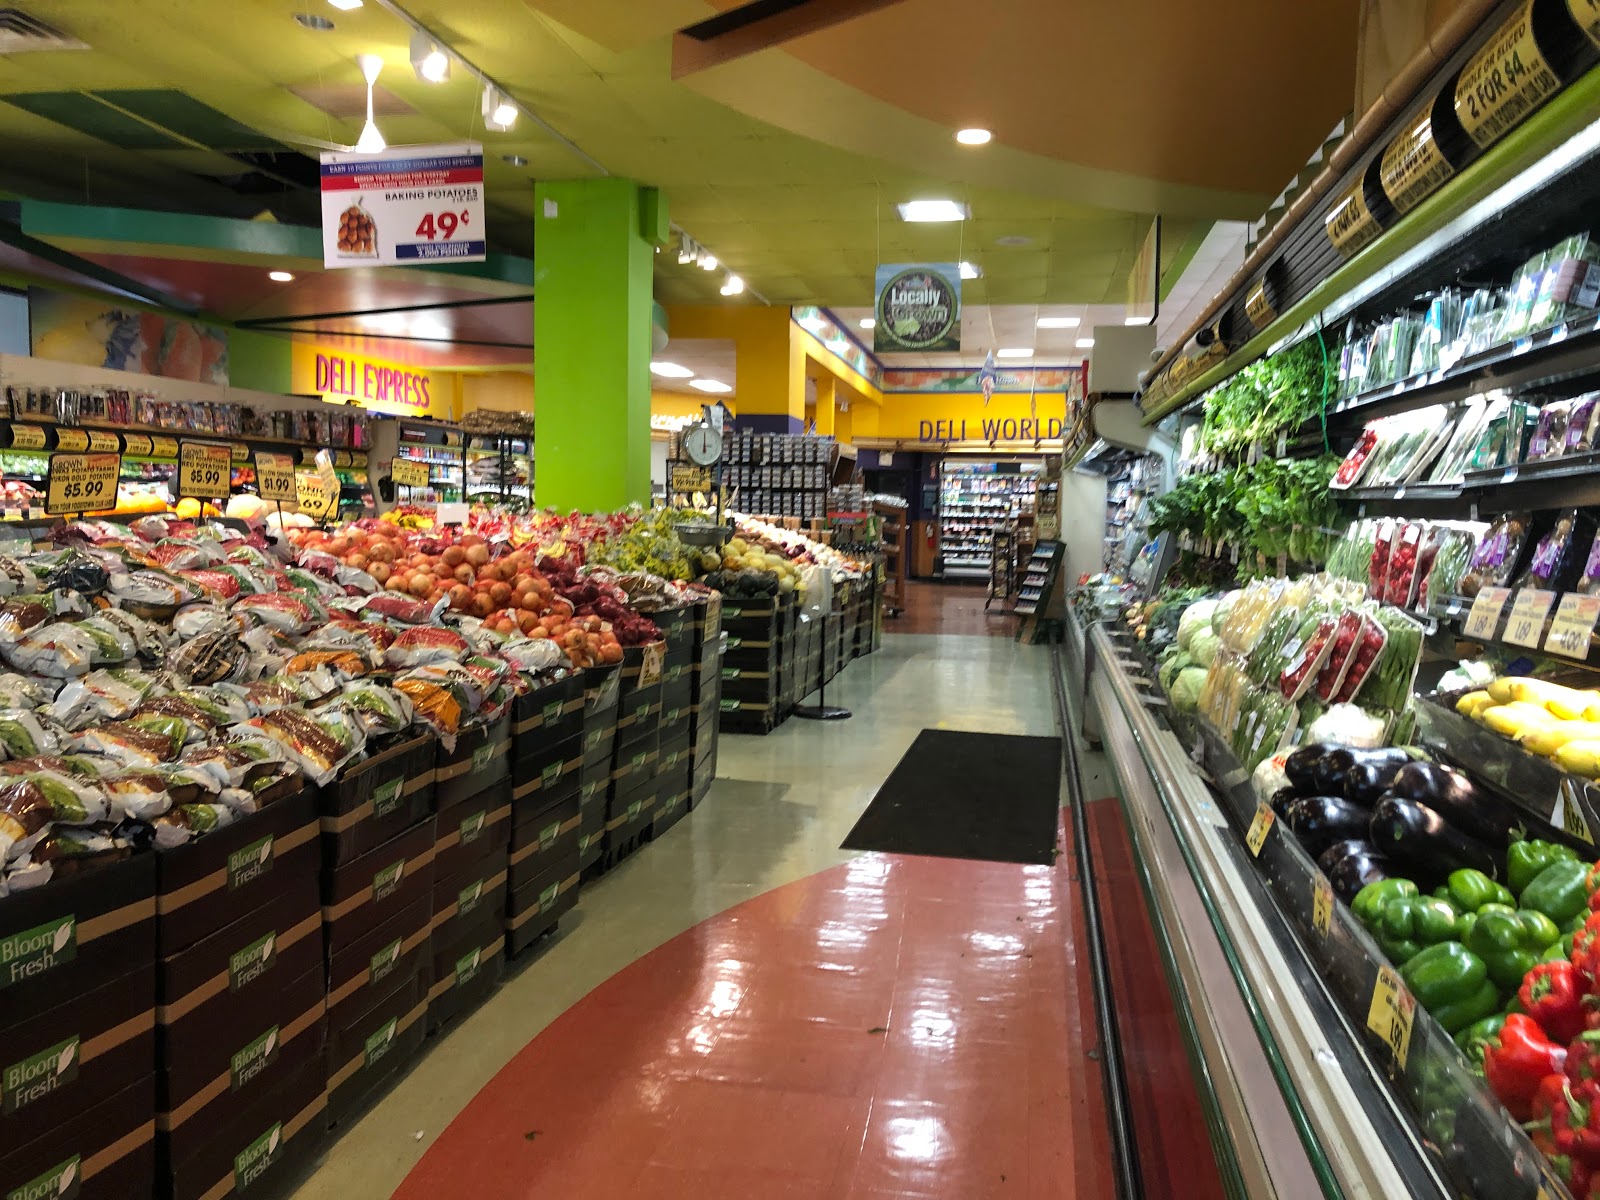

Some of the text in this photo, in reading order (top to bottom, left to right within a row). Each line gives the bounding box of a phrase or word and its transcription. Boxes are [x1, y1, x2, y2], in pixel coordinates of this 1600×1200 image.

[1467, 94, 1480, 119] 2
[1476, 68, 1508, 111] FOR
[385, 187, 478, 201] BAKING POTATOES
[440, 247, 469, 257] POINTS
[891, 286, 941, 308] Locally
[892, 304, 947, 323] Grown
[316, 353, 430, 409] DELI EXPRESS
[919, 418, 1062, 443] DELI WORLD
[53, 459, 82, 470] GROWN
[89, 472, 115, 480] POTATOES
[191, 469, 219, 486] $5.99
[264, 476, 289, 492] $1.99
[64, 481, 103, 499] $5.99
[231, 847, 262, 871] Bloom
[1, 929, 57, 961] Bloom
[234, 945, 264, 971] Bloom
[235, 1040, 267, 1071] Bloom
[8, 1051, 61, 1090] Bloom
[238, 1137, 271, 1173] Bloom
